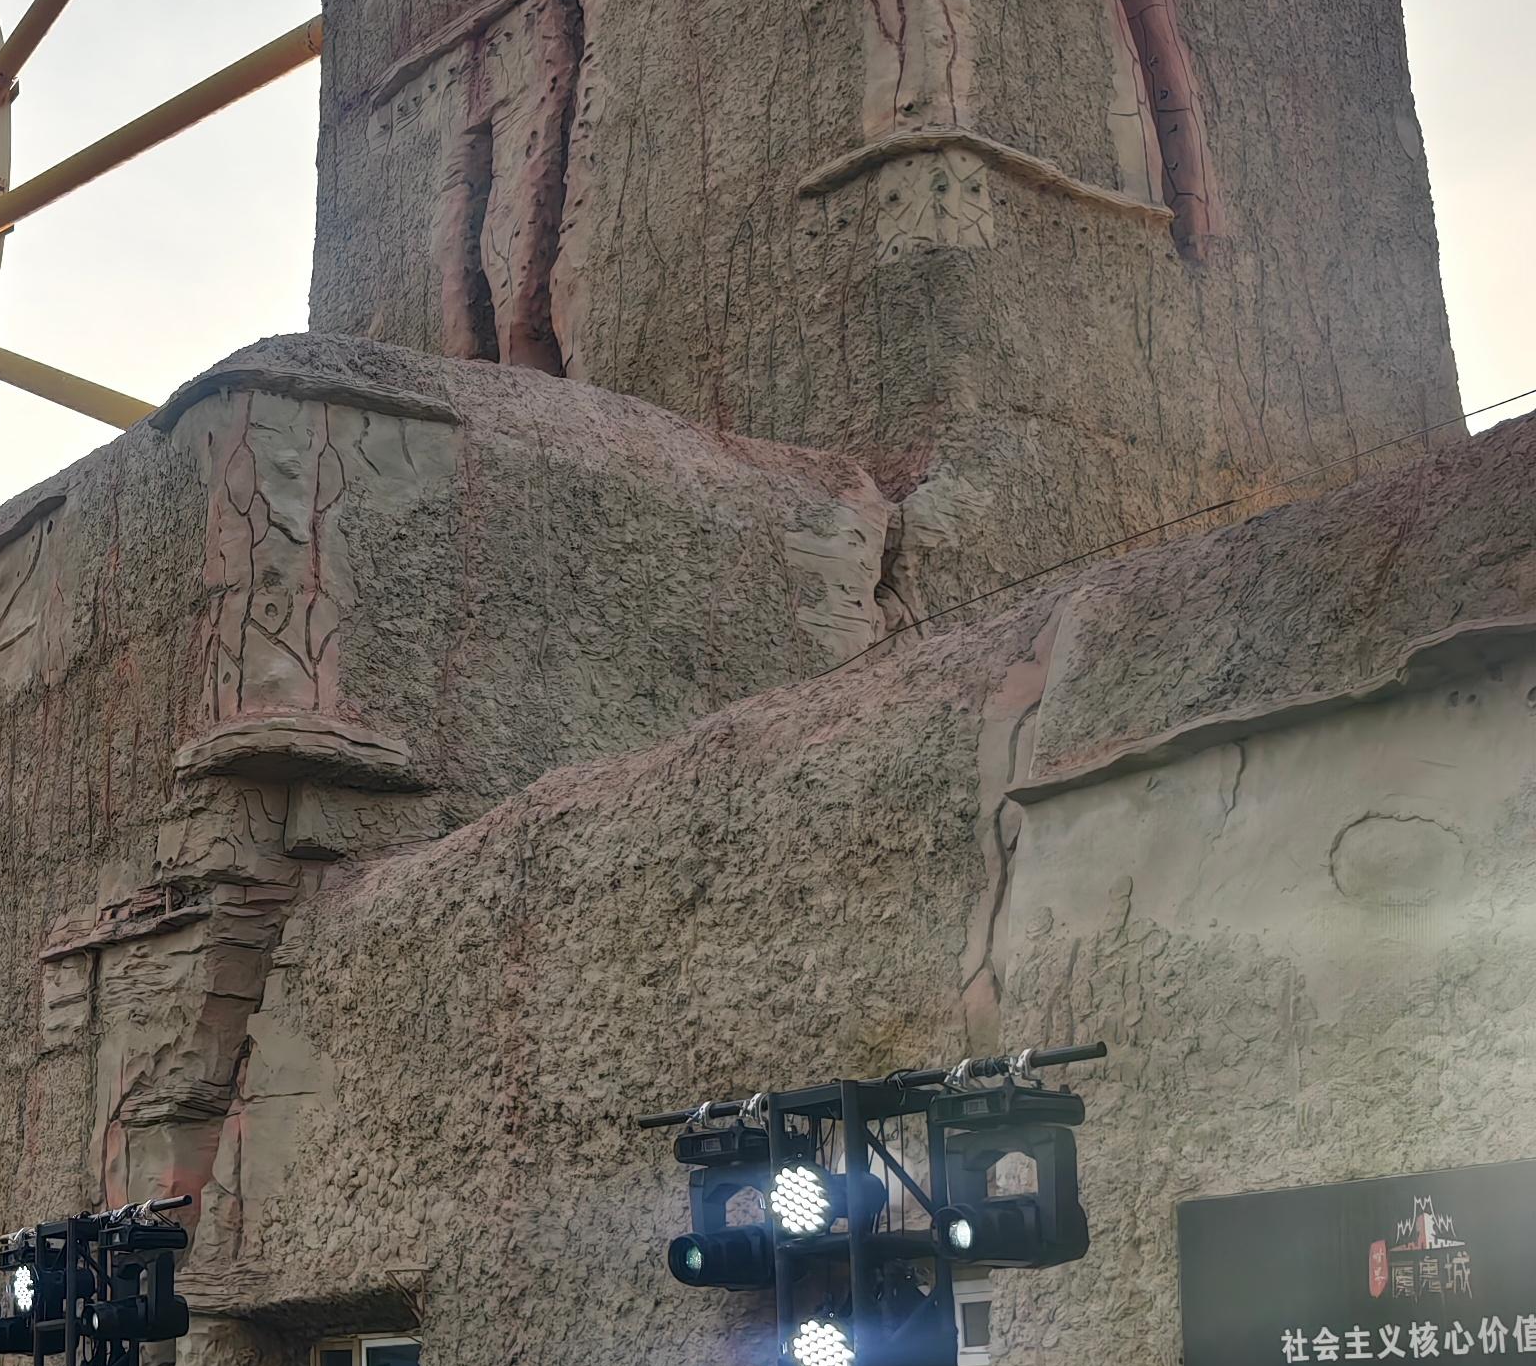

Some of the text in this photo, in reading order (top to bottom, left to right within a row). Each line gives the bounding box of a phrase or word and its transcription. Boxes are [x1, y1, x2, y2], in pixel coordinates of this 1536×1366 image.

[1281, 1314, 1536, 1364] 社会主义核心价值
